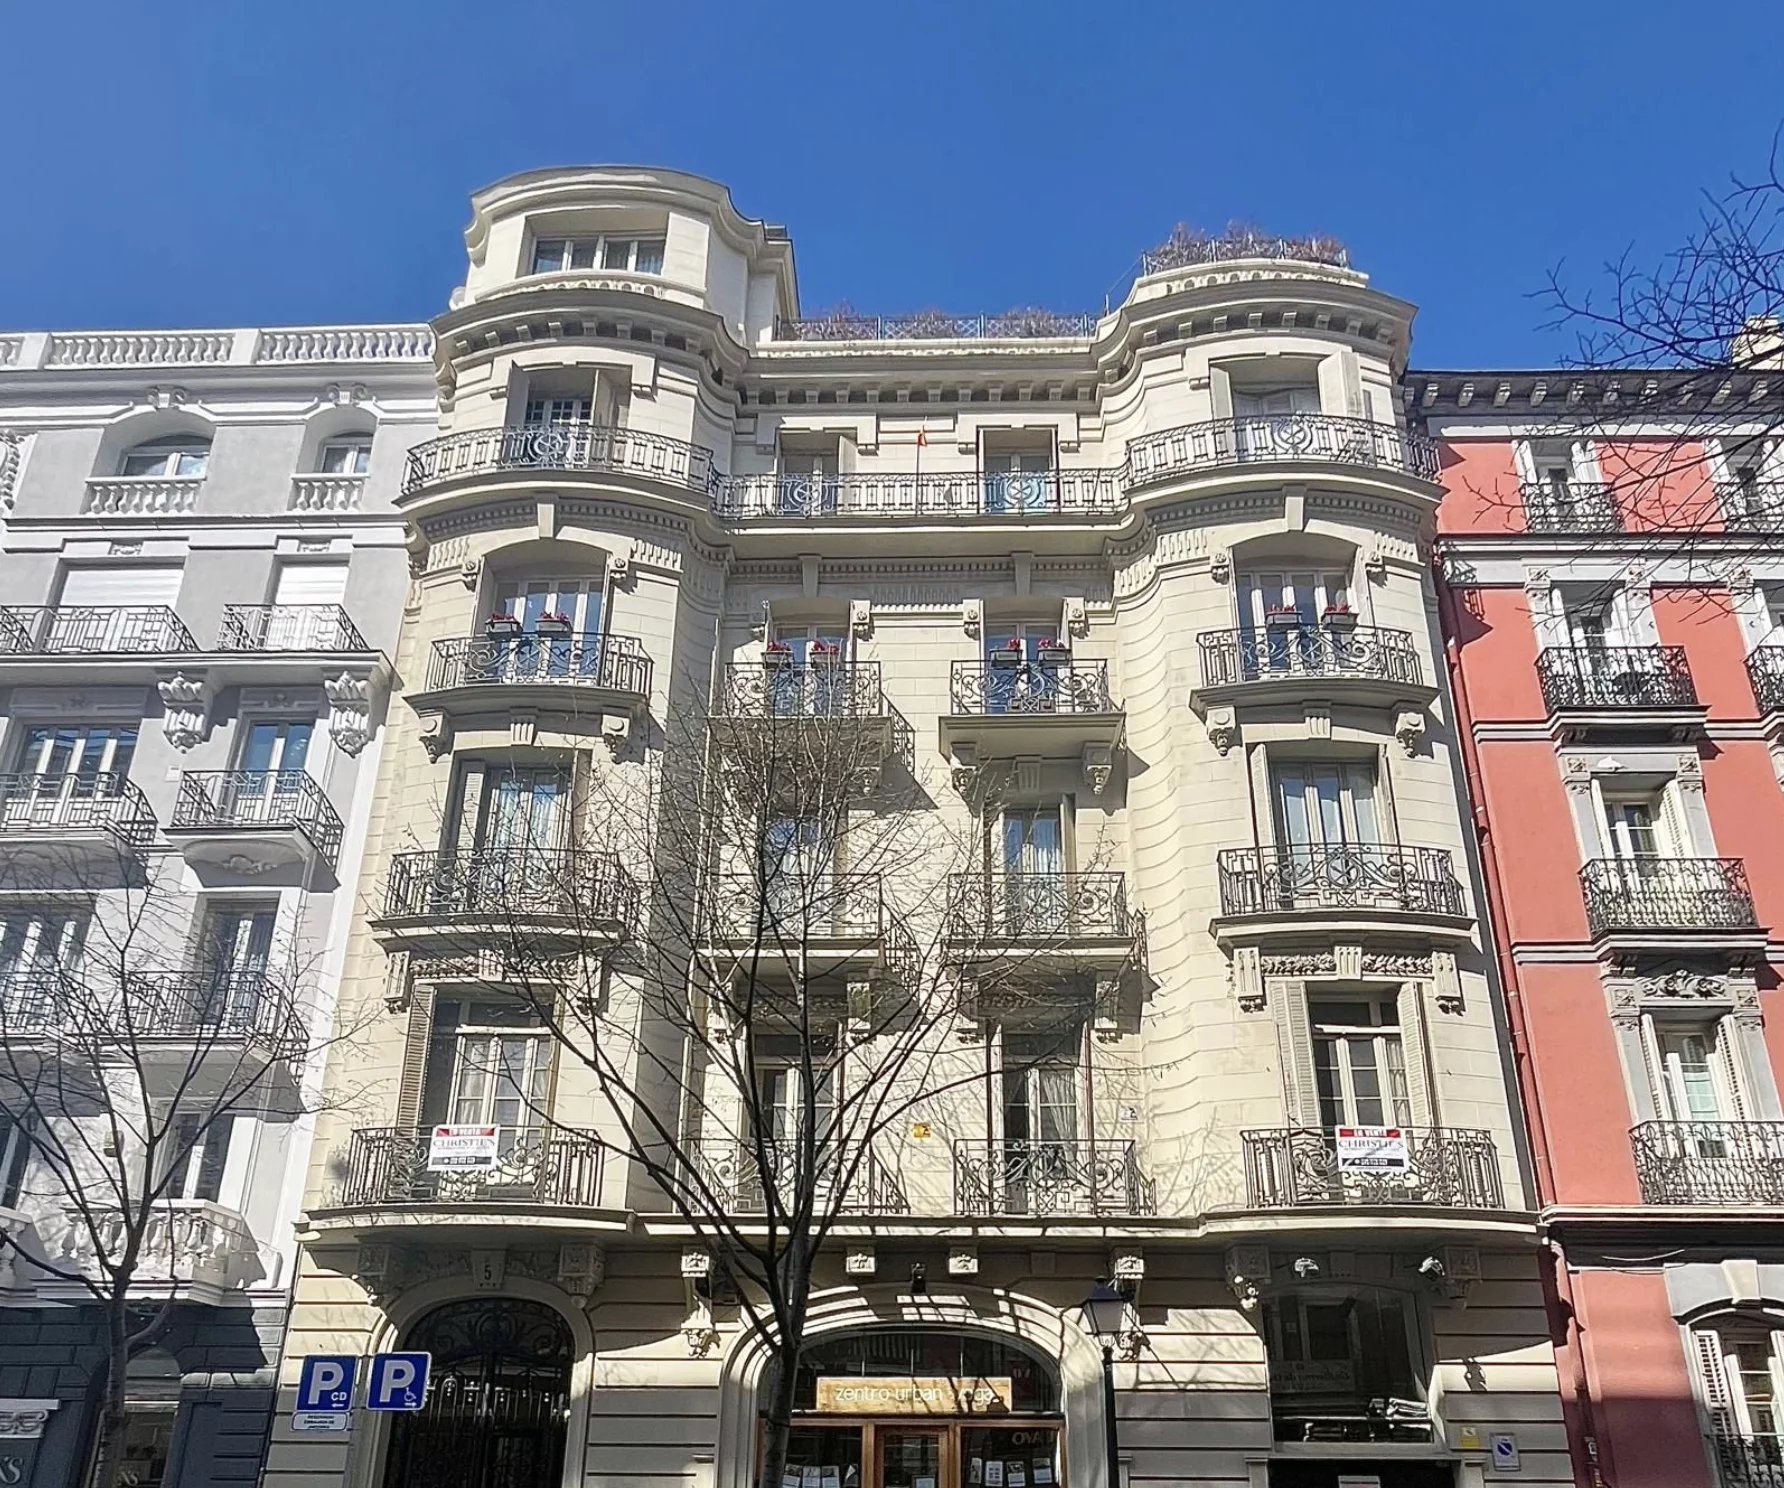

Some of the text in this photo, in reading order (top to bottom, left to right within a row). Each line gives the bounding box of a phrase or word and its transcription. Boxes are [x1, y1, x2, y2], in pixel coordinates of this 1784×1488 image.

[484, 1264, 492, 1280] 5
[308, 1361, 344, 1405] P
[379, 1359, 416, 1403] P
[331, 1391, 348, 1401] CD
[835, 1386, 890, 1402] zentro
[895, 1386, 943, 1402] urban
